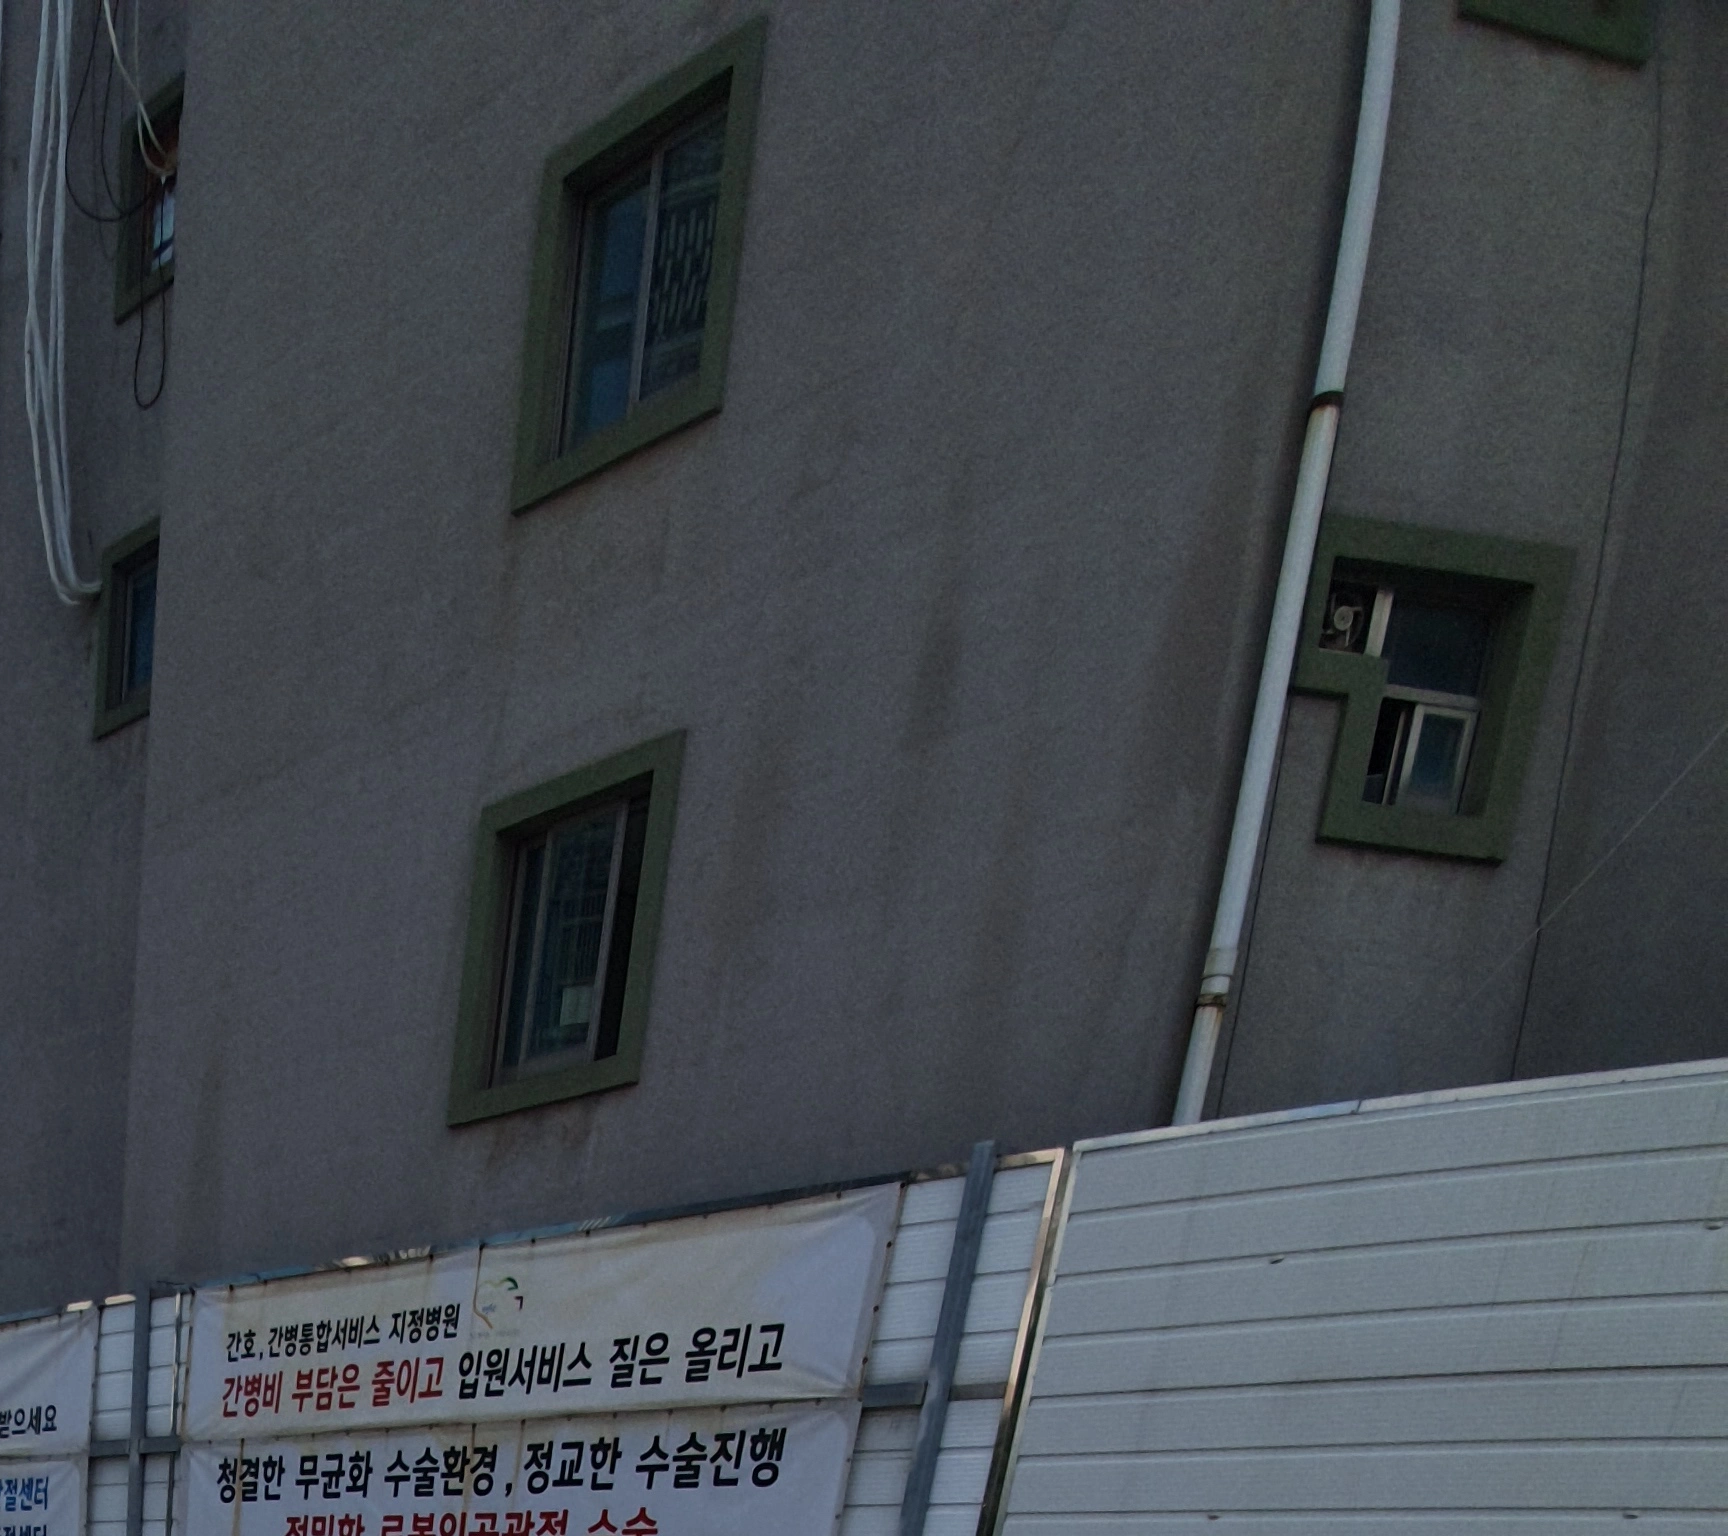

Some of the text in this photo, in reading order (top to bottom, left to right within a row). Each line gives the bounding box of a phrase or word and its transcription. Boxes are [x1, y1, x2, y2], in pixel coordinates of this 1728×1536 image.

[389, 1302, 461, 1345] 지정병원
[222, 1323, 786, 1418] 간병비 부담은 줄이고 입원서비스 질은 올리고
[216, 1455, 286, 1503] 청결한
[295, 1450, 373, 1500] 무균화
[523, 1436, 622, 1494] 정교한
[635, 1427, 787, 1491] 수술진행
